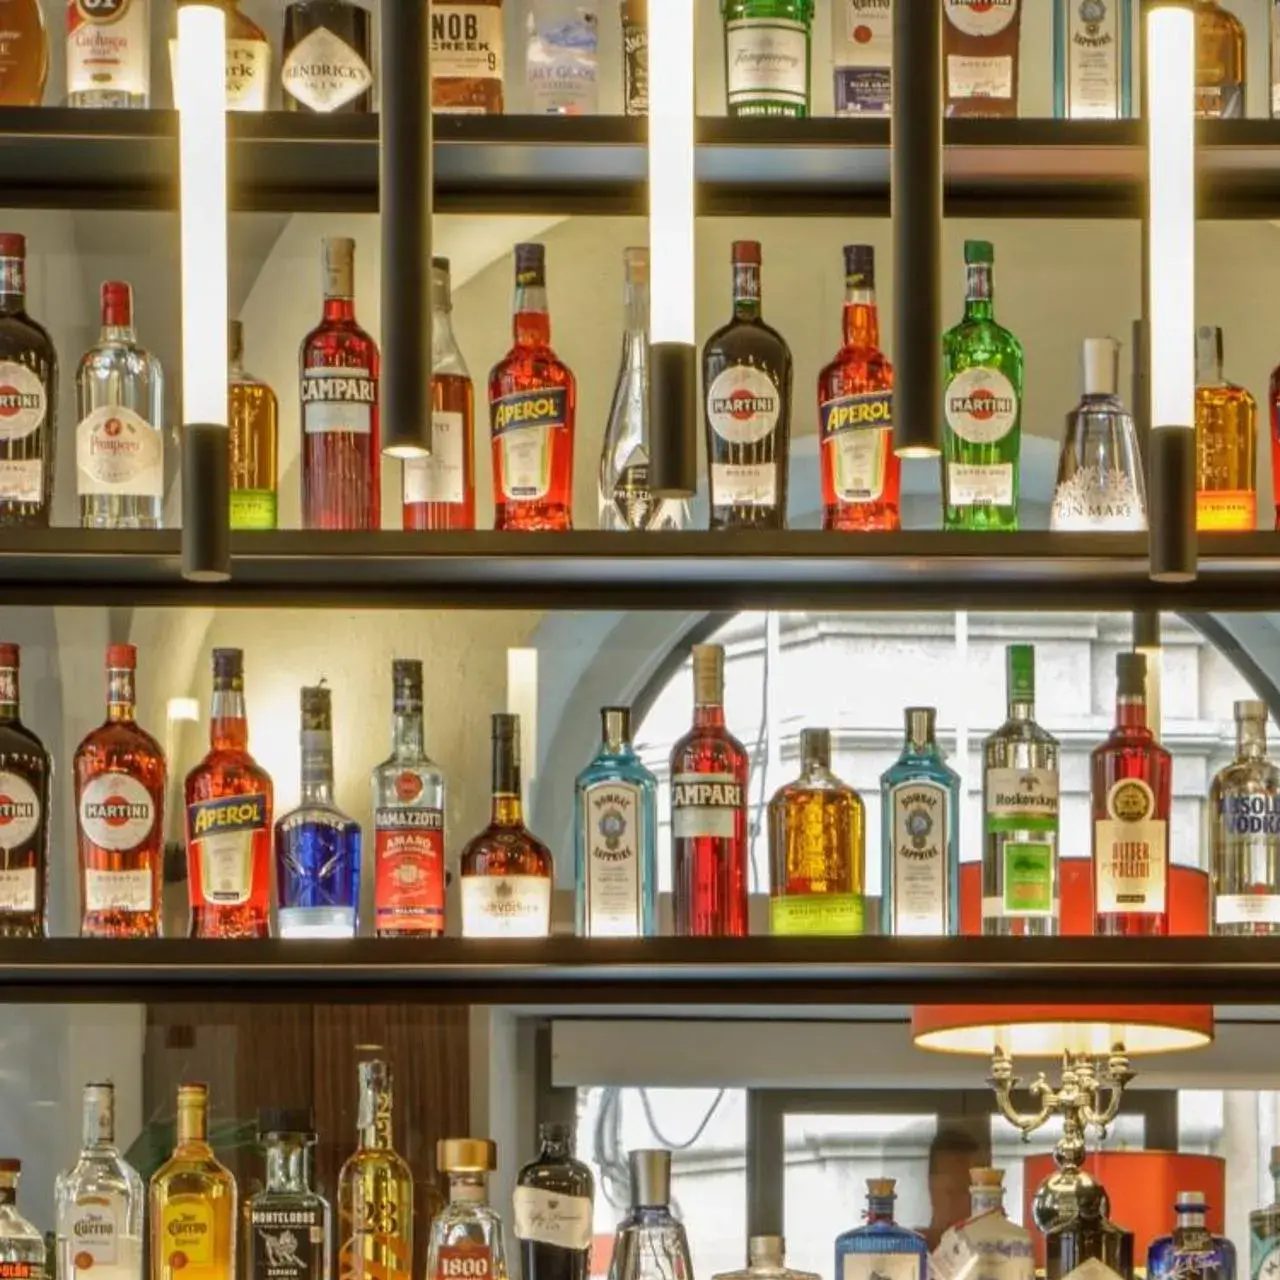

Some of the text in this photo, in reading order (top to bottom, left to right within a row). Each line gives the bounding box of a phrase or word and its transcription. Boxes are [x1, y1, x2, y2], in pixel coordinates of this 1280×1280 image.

[432, 14, 477, 41] NOB
[301, 378, 375, 402] CAMPARI
[0, 393, 39, 409] RTINI
[713, 398, 773, 413] MARTINI
[951, 398, 1012, 412] MARTINI
[495, 400, 559, 428] APEROL
[827, 402, 891, 431] APEROL
[675, 784, 741, 806] AMPARI
[0, 803, 33, 817] TINI
[86, 804, 149, 818] MARTINI
[195, 802, 260, 833] APEROL
[74, 1220, 113, 1237] Cuervo
[168, 1220, 207, 1237] Cuervo
[442, 1257, 488, 1277] 1800
